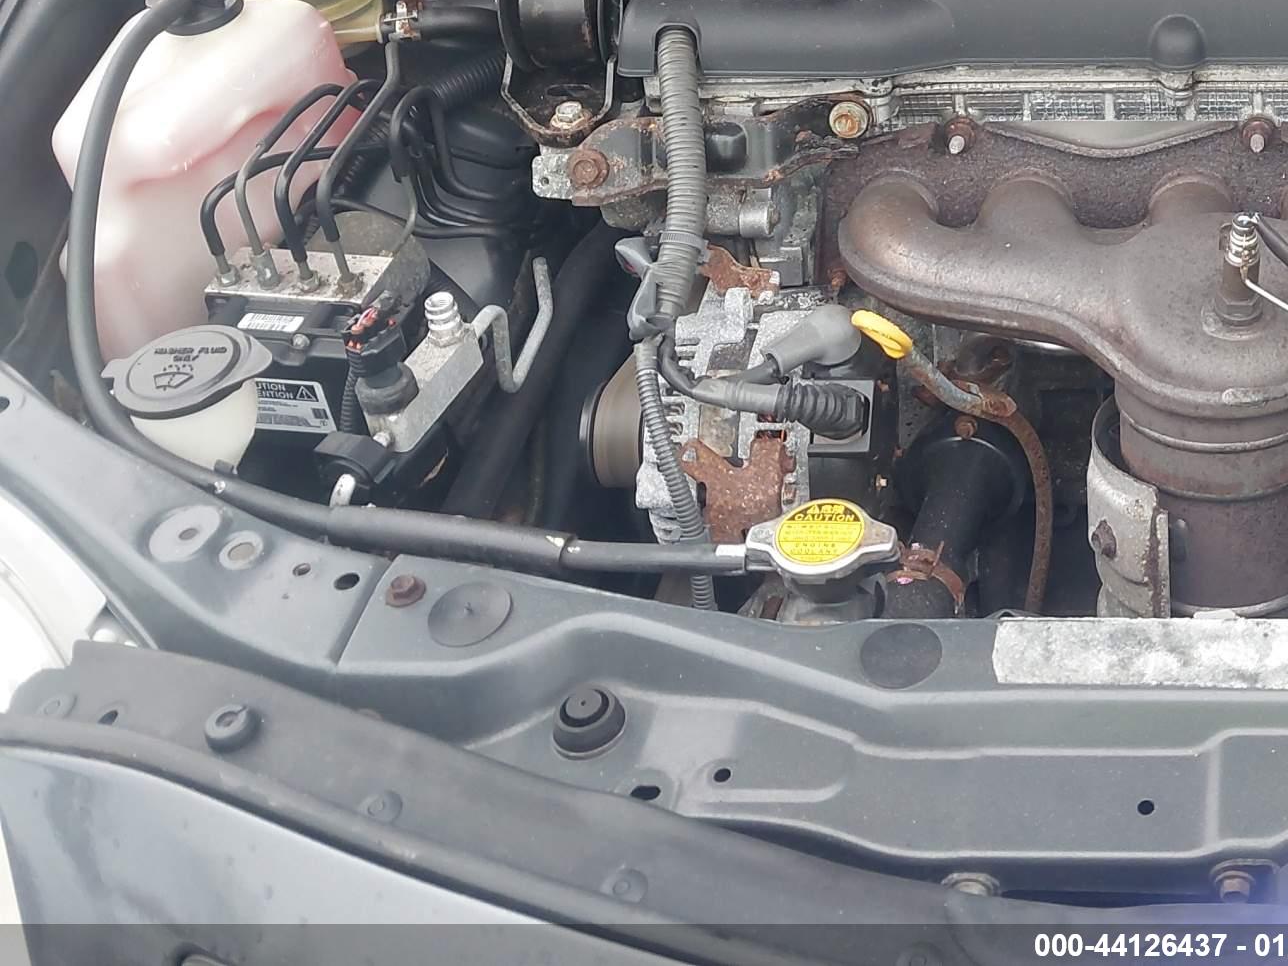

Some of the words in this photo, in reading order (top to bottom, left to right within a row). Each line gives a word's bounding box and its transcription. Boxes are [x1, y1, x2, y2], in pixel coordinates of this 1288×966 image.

[256, 381, 287, 392] UTION
[257, 390, 295, 400] ENTION
[794, 513, 855, 522] CAUTION
